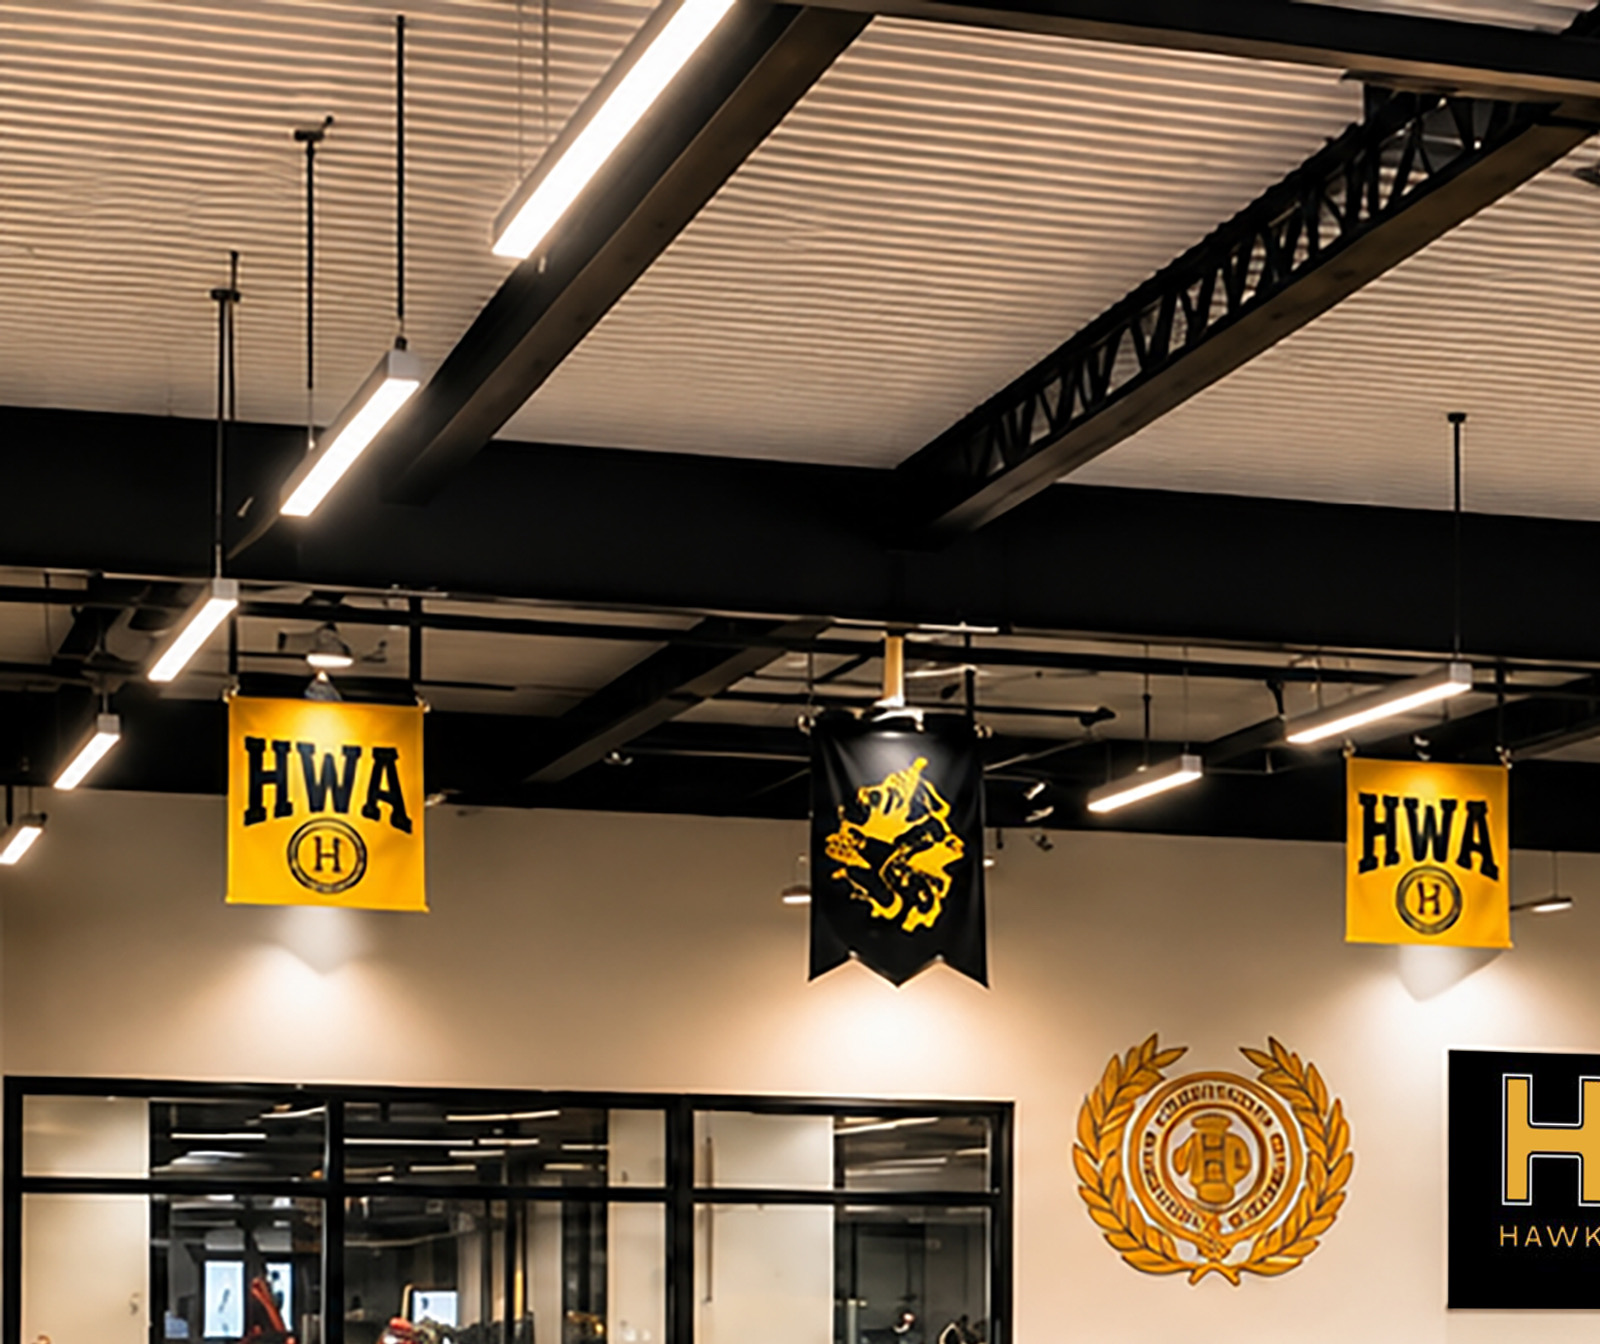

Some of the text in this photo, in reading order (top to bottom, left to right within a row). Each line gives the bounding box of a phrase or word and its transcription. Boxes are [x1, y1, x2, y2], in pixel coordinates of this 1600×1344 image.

[243, 736, 413, 835] HWA
[313, 835, 342, 874] H
[1358, 791, 1499, 882] HWA
